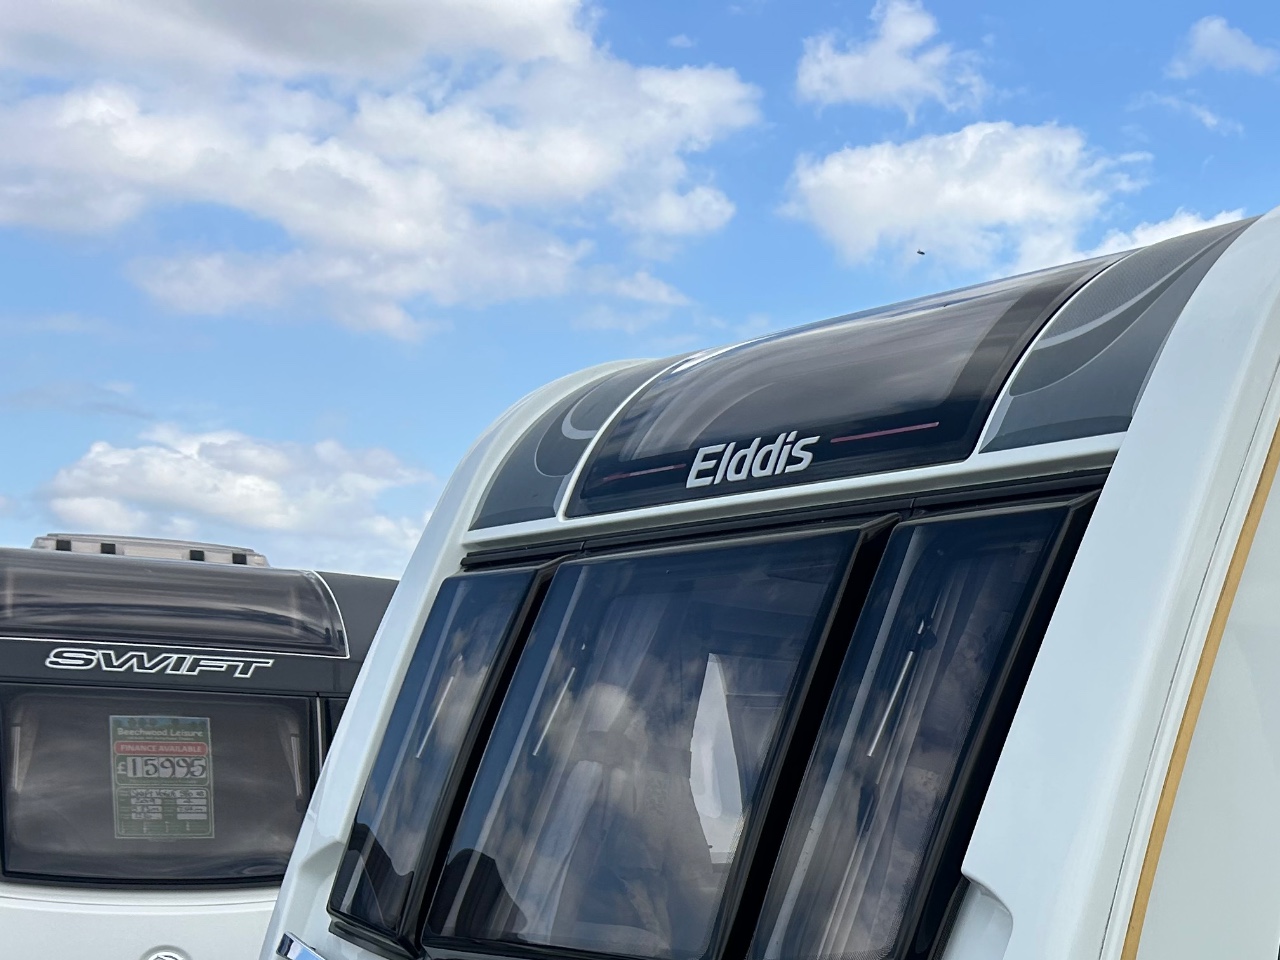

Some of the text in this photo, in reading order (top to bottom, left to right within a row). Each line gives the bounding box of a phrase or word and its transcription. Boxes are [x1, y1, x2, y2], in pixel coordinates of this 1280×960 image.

[686, 430, 821, 488] Elddis
[45, 647, 275, 679] SWIFT
[117, 727, 204, 737] Beechwood Leisure
[120, 744, 202, 753] FINANCE AVAILABLE
